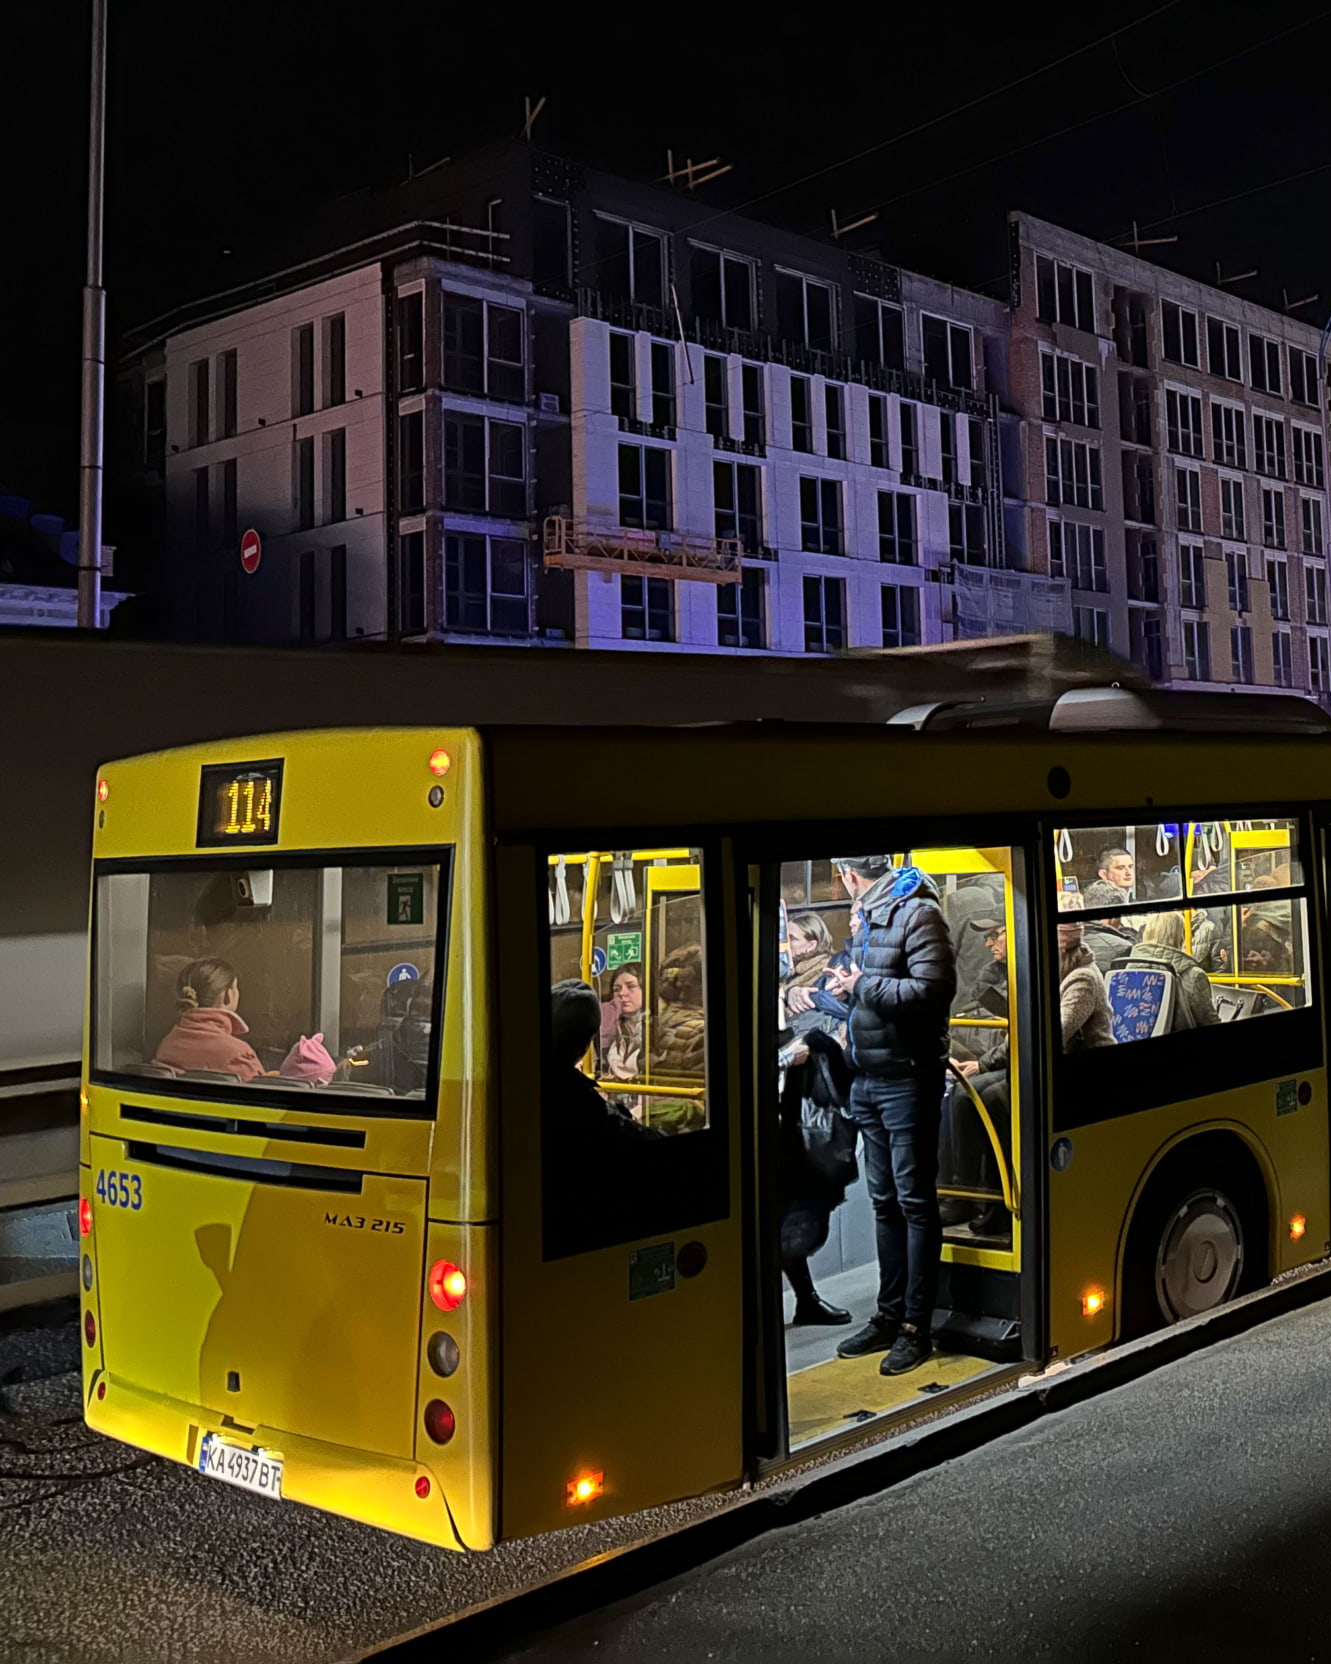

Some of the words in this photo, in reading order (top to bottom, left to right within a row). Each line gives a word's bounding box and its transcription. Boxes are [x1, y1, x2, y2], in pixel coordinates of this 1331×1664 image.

[226, 778, 271, 834] 114
[96, 1169, 142, 1211] 4653
[371, 1218, 405, 1234] 215
[228, 1452, 258, 1484] 4937
